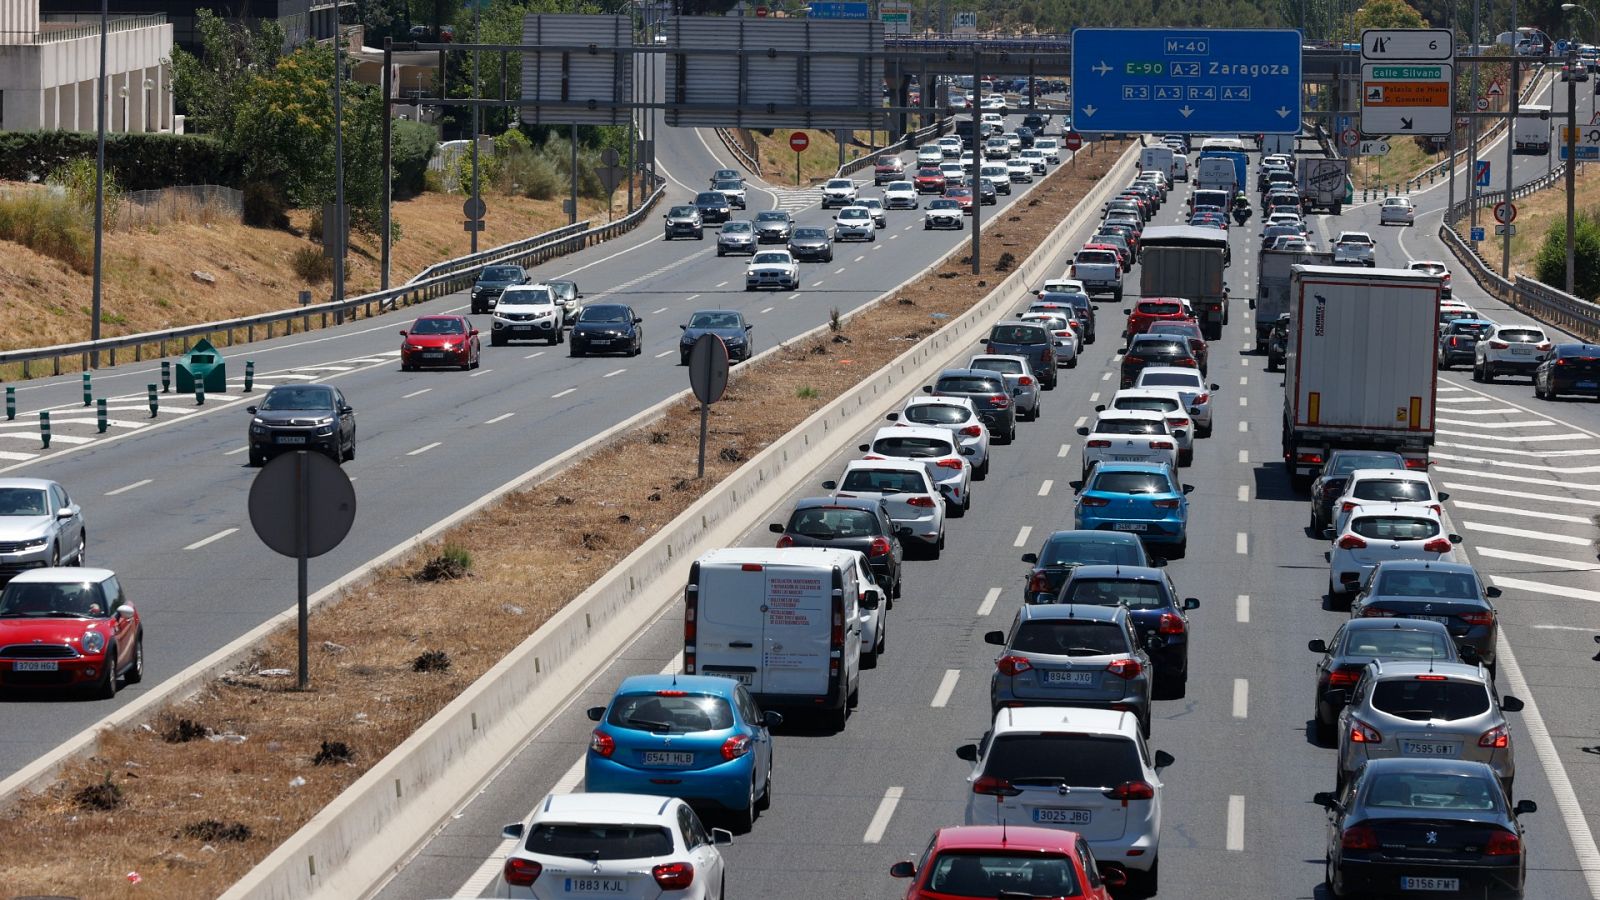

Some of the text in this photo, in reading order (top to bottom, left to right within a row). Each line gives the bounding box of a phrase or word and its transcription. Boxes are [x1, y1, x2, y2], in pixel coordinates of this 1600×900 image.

[1167, 41, 1206, 51] M-40
[1429, 40, 1438, 50] 6
[1126, 62, 1290, 77] E-90 A-2 Zaragoza
[1373, 68, 1440, 77] calle Silvano
[1124, 88, 1249, 99] R-3 A-3 R-4 A-4
[1380, 144, 1386, 152] 6
[19, 662, 39, 671] 3709
[1049, 672, 1091, 682] 8948 JXG
[1408, 743, 1433, 754] 7595
[646, 753, 692, 764] 6541 HLB
[1040, 810, 1089, 822] 3025 JBG
[573, 880, 623, 892] 1883 KJL
[1407, 878, 1458, 891] 9156 FMT
